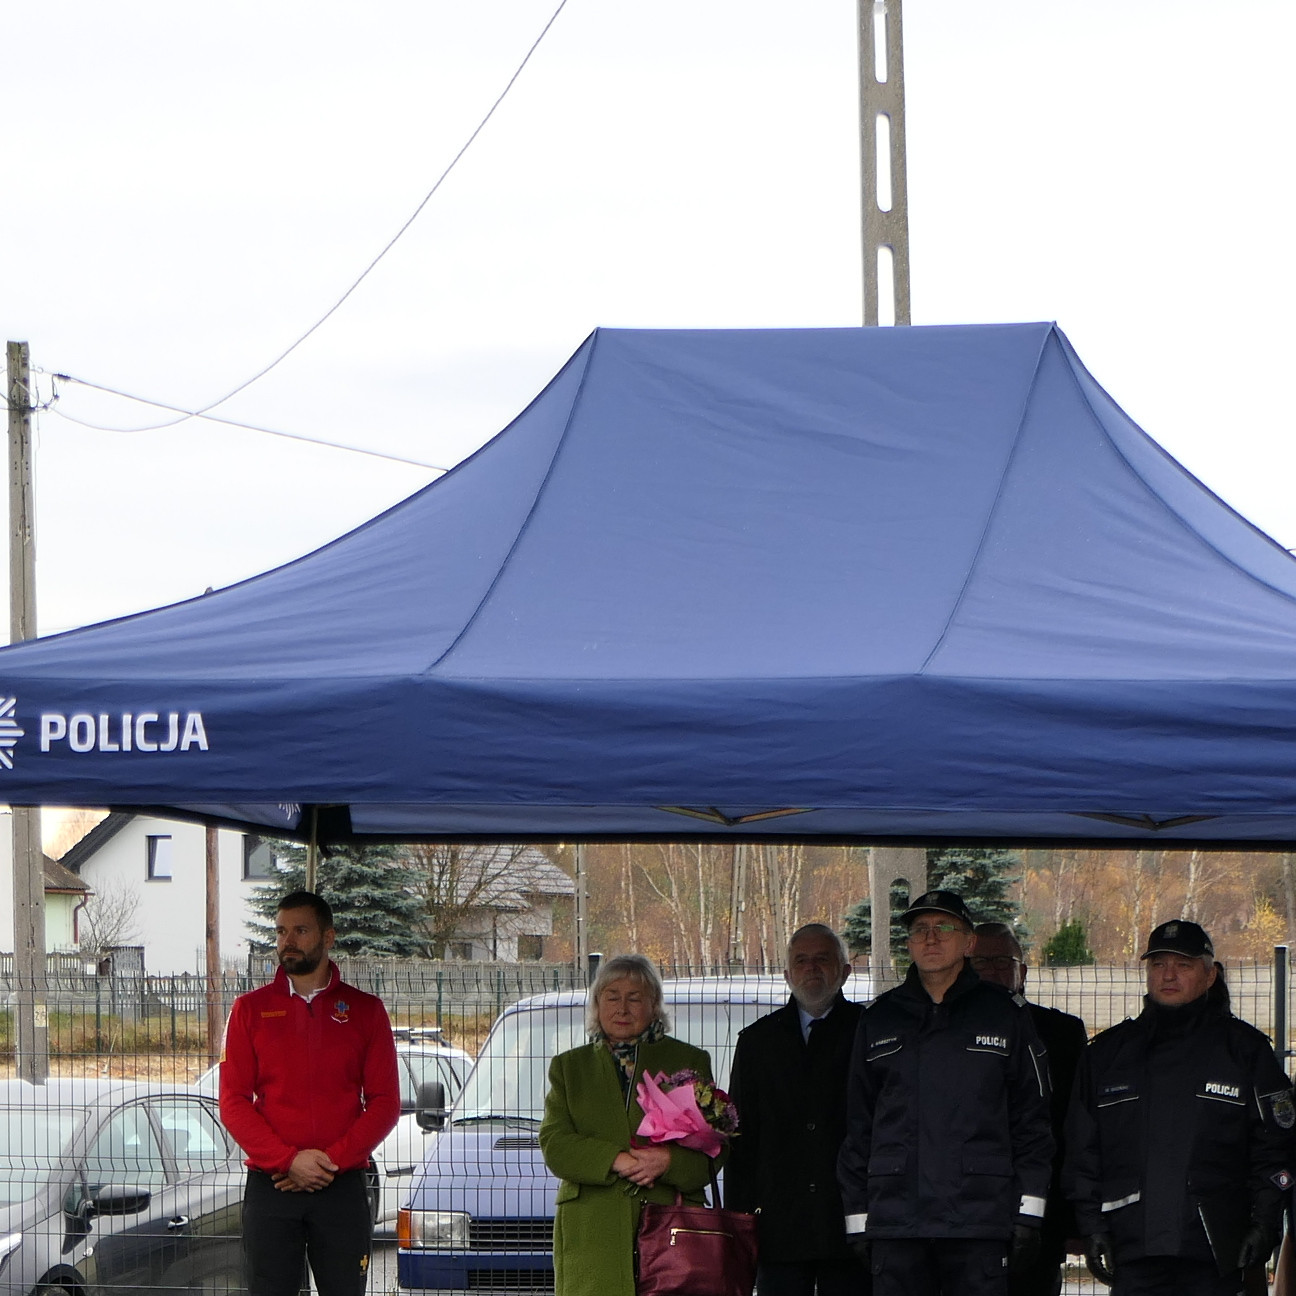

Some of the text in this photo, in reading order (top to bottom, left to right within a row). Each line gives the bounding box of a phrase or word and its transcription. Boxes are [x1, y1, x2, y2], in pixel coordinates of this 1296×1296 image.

[40, 713, 209, 752] POLICJA
[975, 1035, 1007, 1049] POLICJA
[1205, 1082, 1239, 1098] POLICJA
